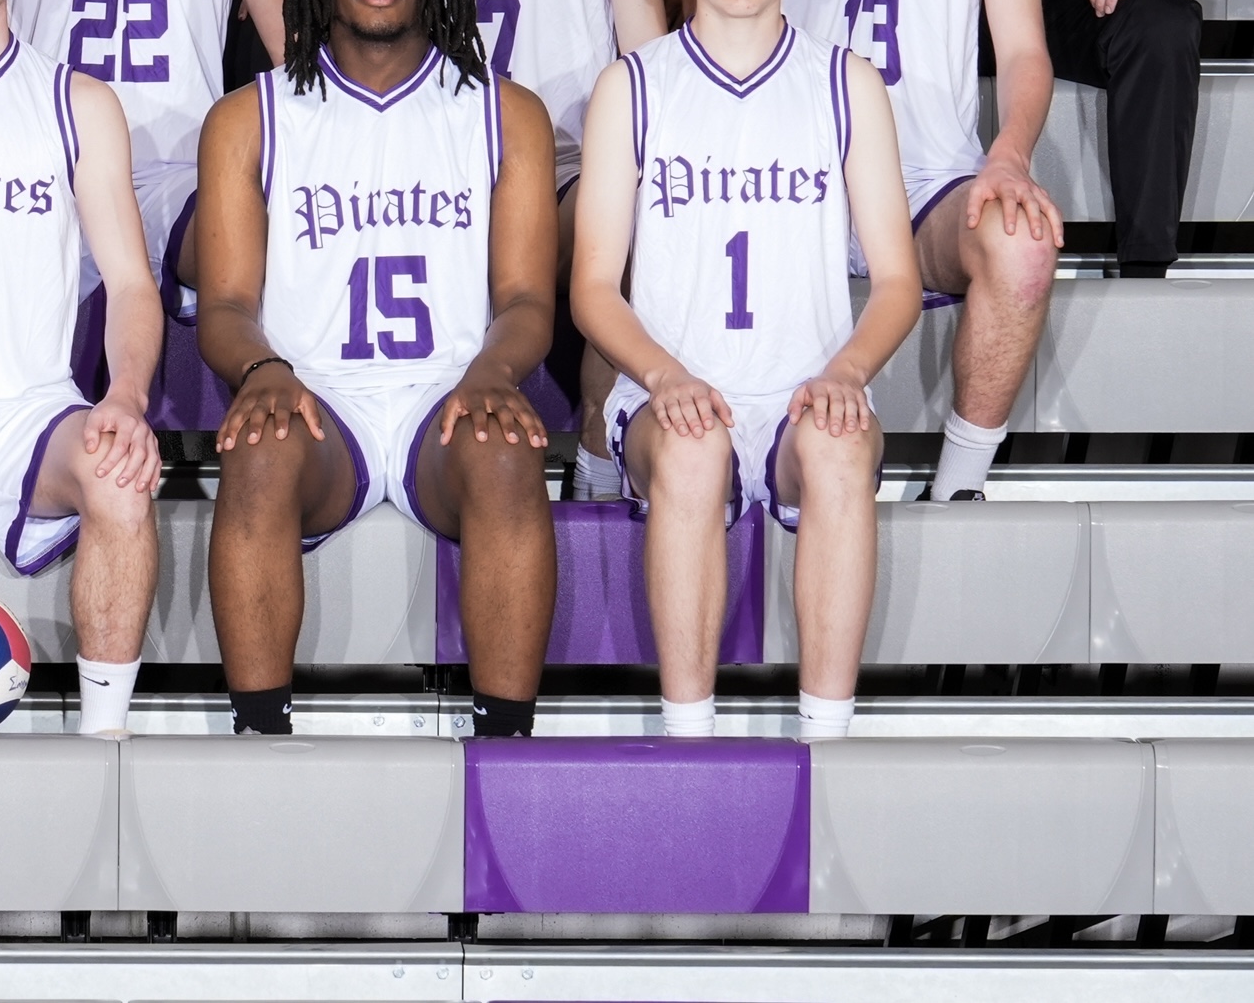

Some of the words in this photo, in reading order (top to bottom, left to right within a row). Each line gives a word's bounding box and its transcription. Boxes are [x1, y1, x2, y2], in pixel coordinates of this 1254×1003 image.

[292, 180, 472, 249] Pirates
[649, 155, 830, 218] Pirates
[341, 255, 435, 360] 15
[725, 231, 754, 329] 1
